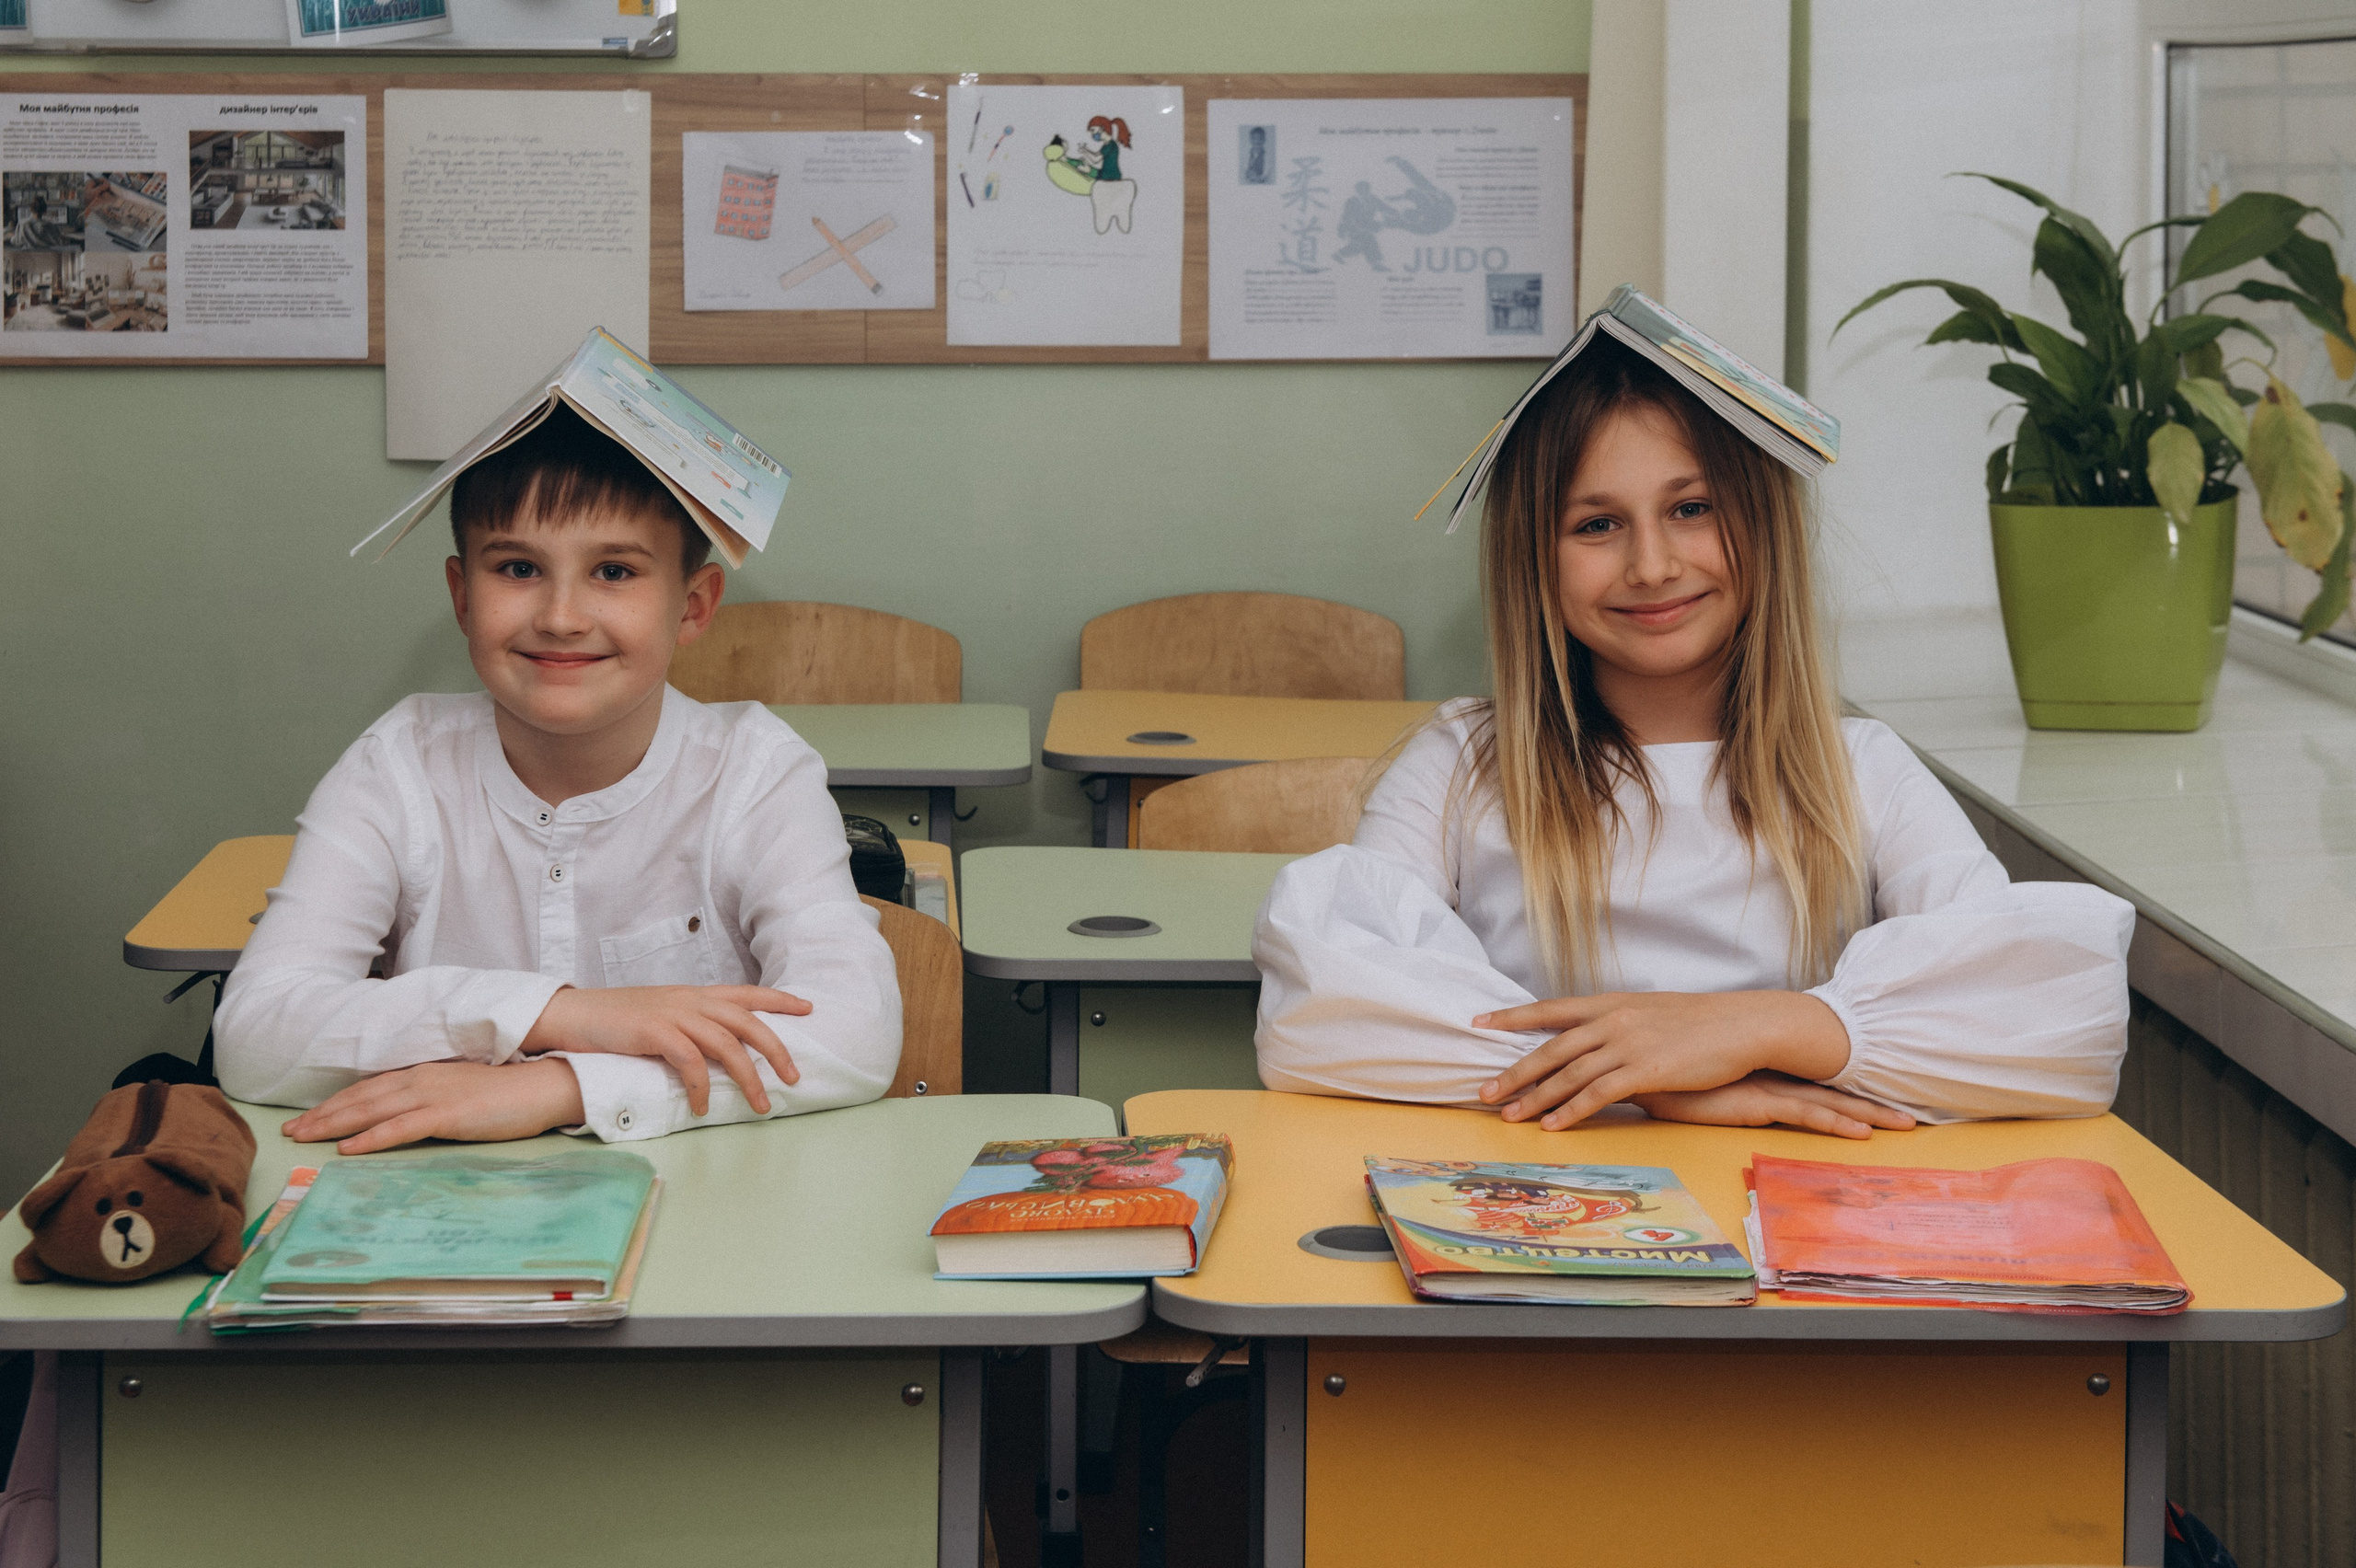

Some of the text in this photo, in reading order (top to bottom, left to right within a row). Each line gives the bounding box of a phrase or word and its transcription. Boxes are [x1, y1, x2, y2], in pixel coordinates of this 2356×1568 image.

[19, 103, 139, 116] Моя майбутня професія
[219, 105, 268, 115] дизайнер
[1403, 247, 1508, 273] JUDO
[1640, 1229, 1674, 1242] 4
[1435, 1245, 1714, 1263] Мистецтво
